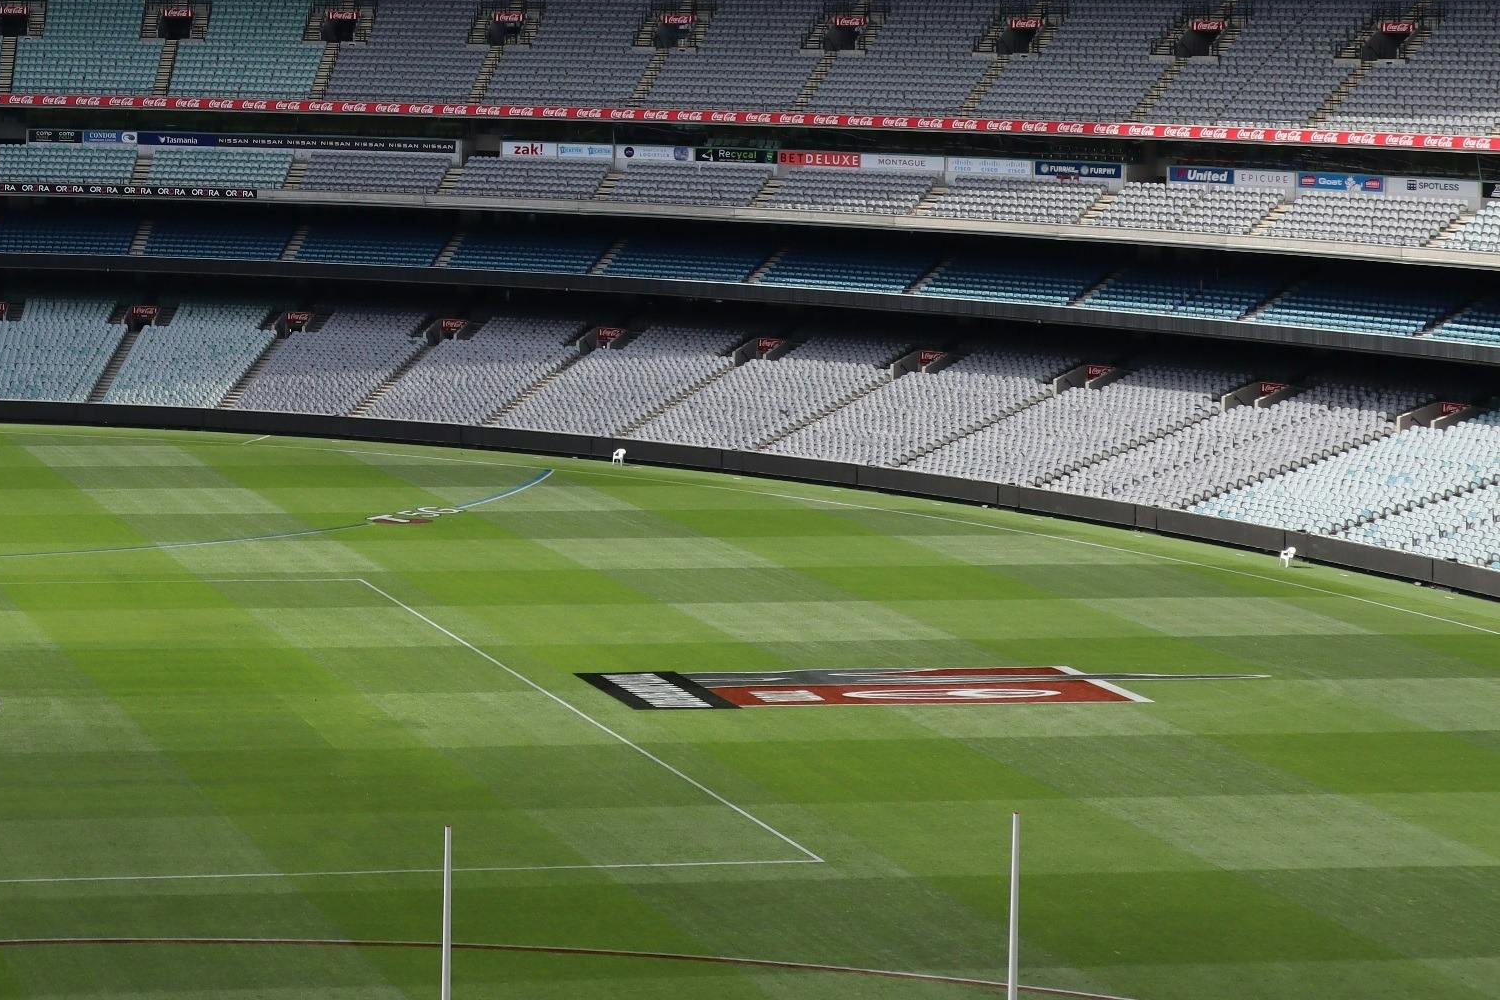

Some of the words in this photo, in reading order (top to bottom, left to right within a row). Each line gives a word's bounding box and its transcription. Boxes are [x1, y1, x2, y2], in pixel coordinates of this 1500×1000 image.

[166, 136, 198, 145] Tasmania
[514, 144, 543, 155] zak!
[718, 149, 757, 159] Recycal
[878, 159, 925, 167] MONTAGUE
[1090, 167, 1116, 175] FURPHY
[1187, 170, 1228, 182] United
[1241, 173, 1289, 183] EPICURE
[1318, 177, 1343, 186] Goat
[1418, 182, 1460, 191] SPOTLESS
